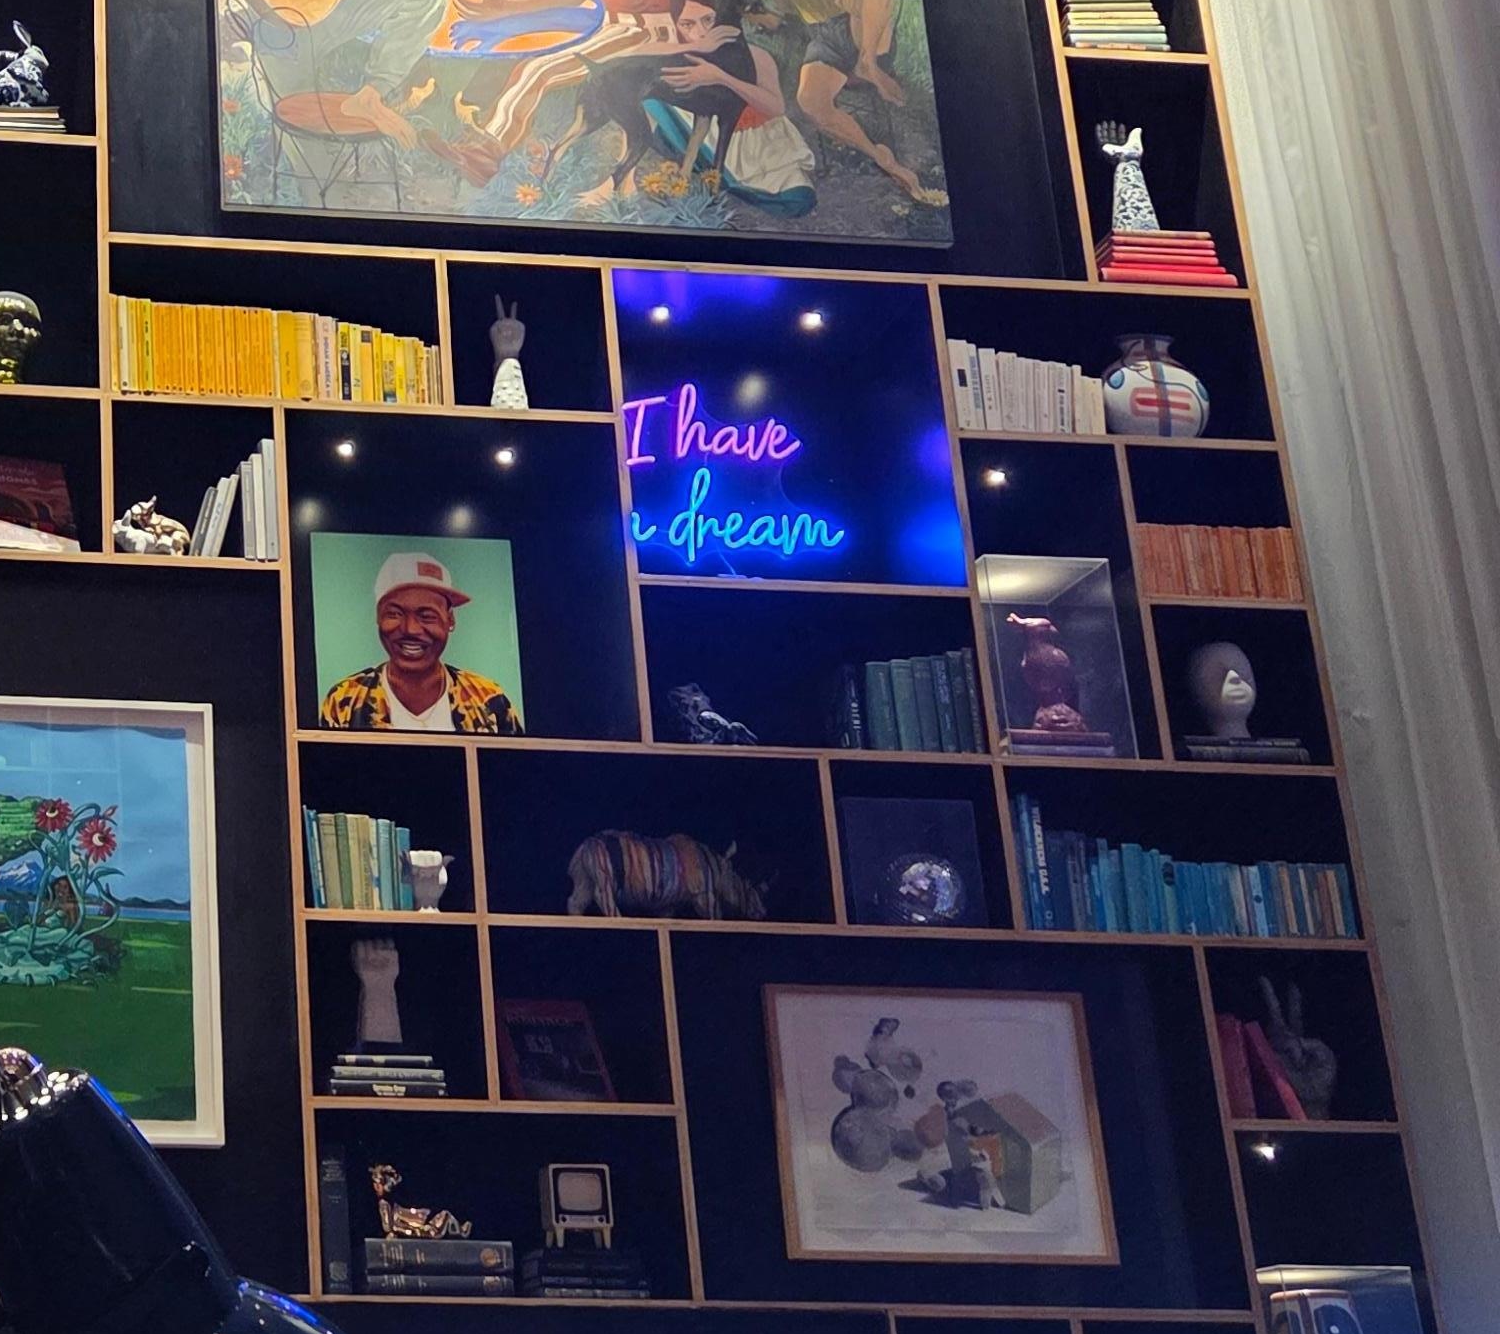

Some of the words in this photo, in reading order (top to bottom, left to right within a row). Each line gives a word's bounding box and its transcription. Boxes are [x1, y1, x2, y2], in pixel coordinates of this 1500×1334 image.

[621, 395, 667, 466] I
[674, 383, 801, 462] have
[668, 467, 845, 562] dream
